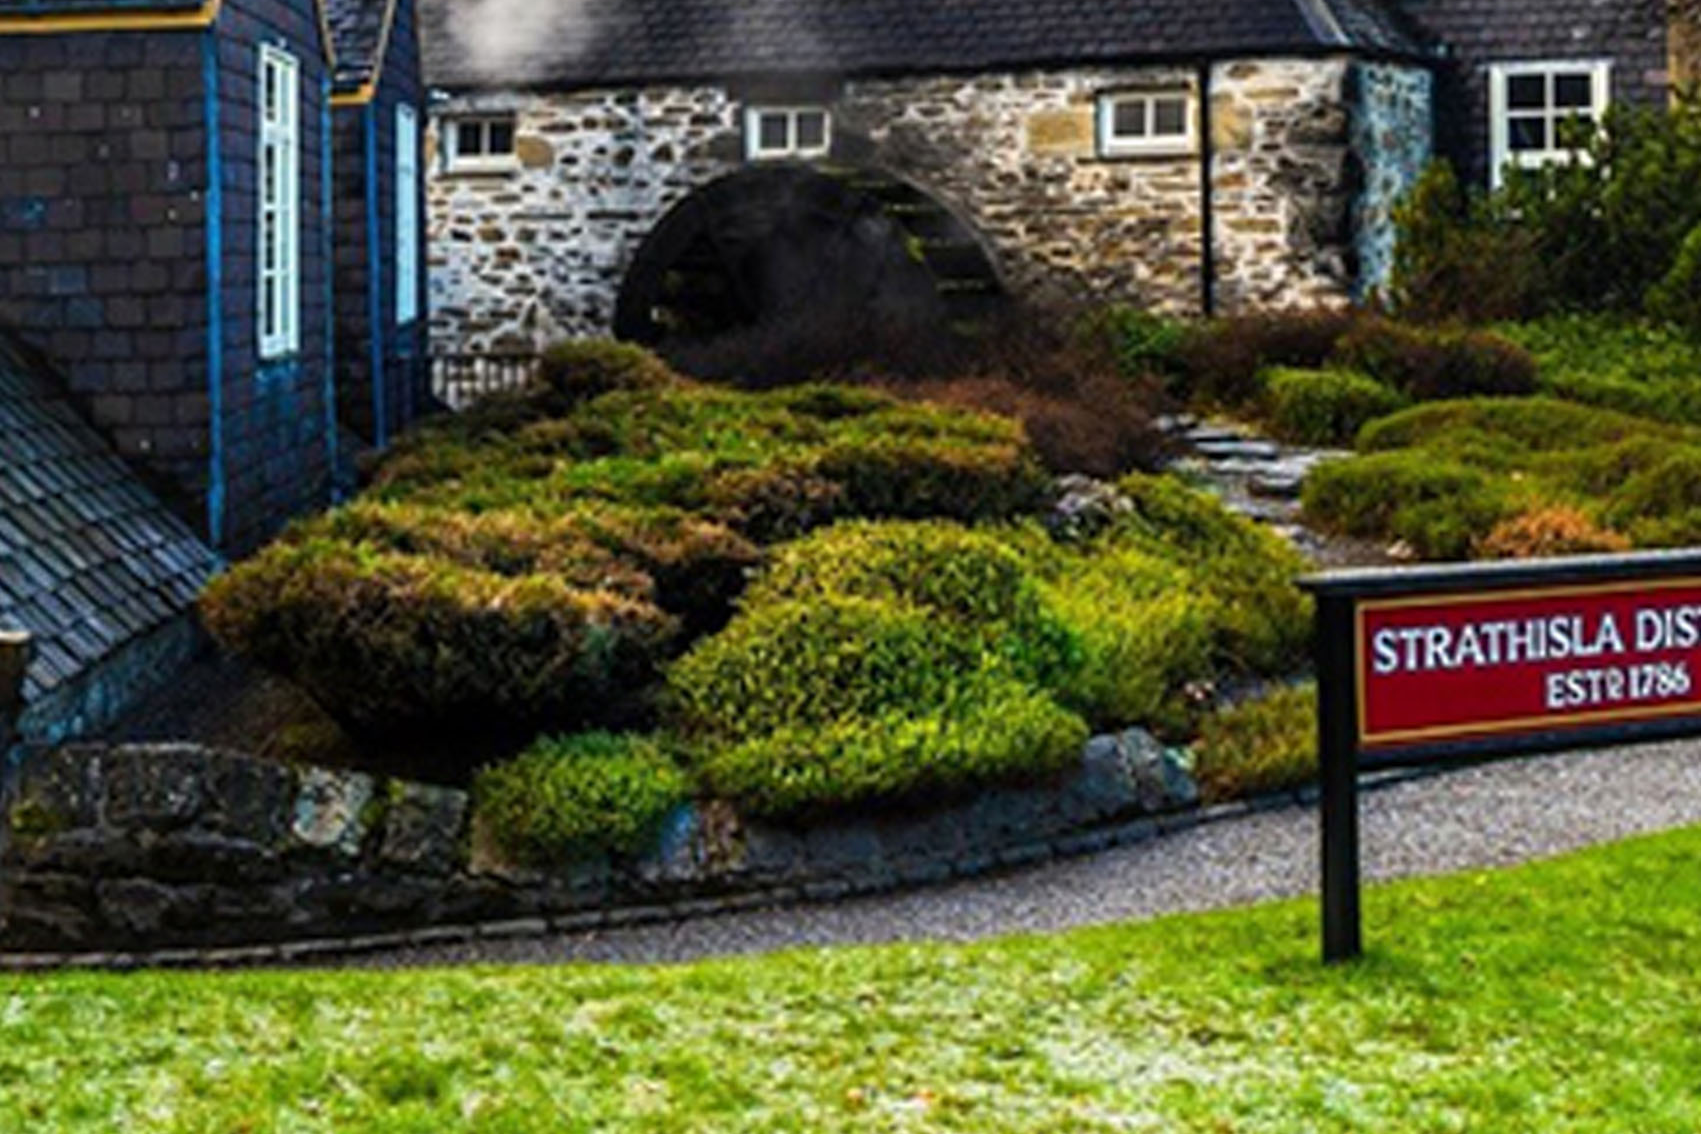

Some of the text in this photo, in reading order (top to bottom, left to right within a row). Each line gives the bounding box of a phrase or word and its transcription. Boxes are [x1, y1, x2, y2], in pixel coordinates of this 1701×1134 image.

[1373, 606, 1701, 673] STRATHISLA DIS
[1629, 662, 1691, 700] 1786
